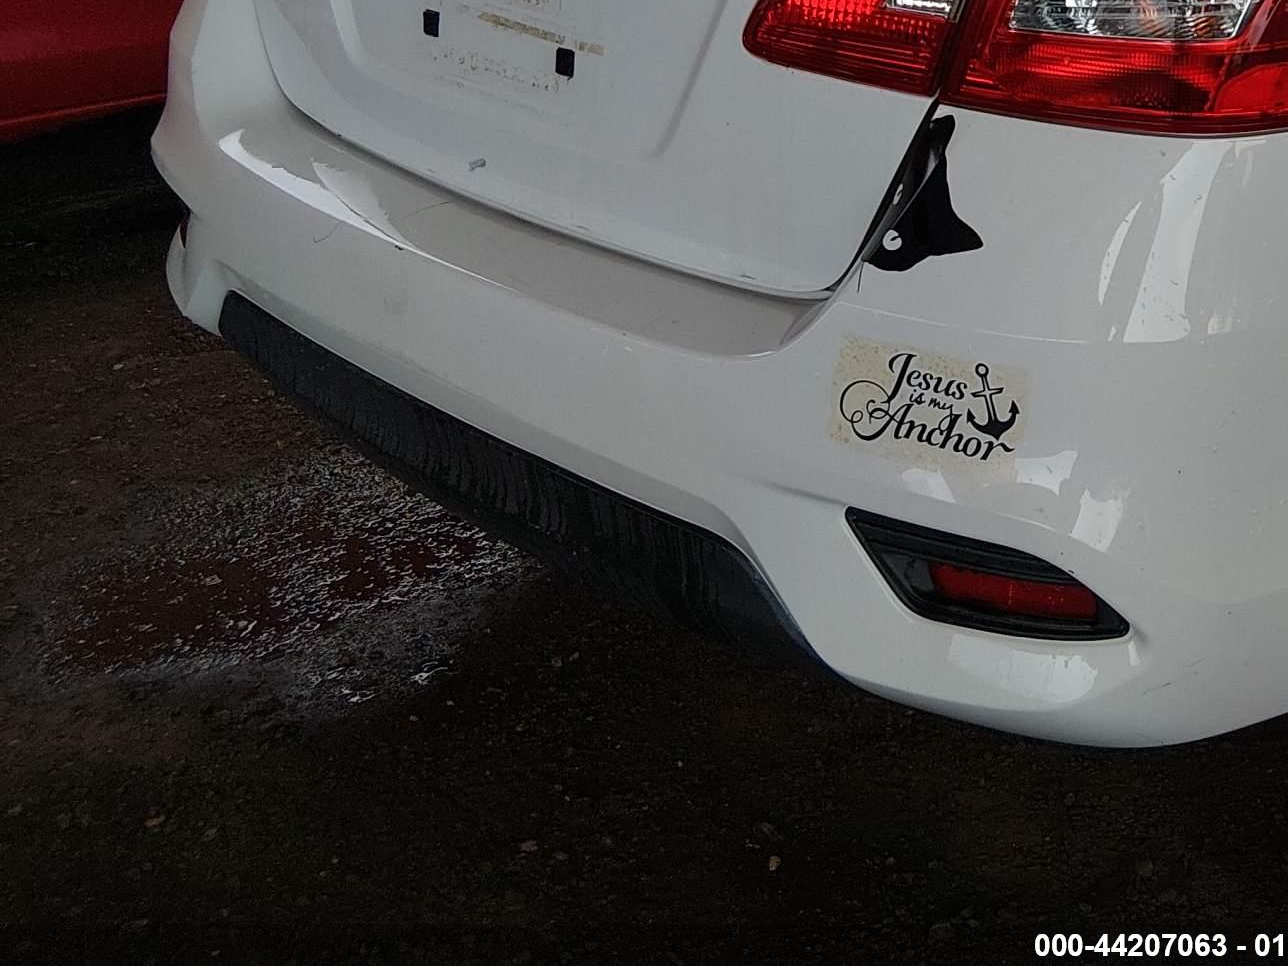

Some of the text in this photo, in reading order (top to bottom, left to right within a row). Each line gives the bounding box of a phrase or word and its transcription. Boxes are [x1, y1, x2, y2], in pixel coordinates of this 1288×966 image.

[884, 352, 968, 403] Jesus
[839, 379, 1015, 461] Anchor
[909, 389, 954, 419] is my
